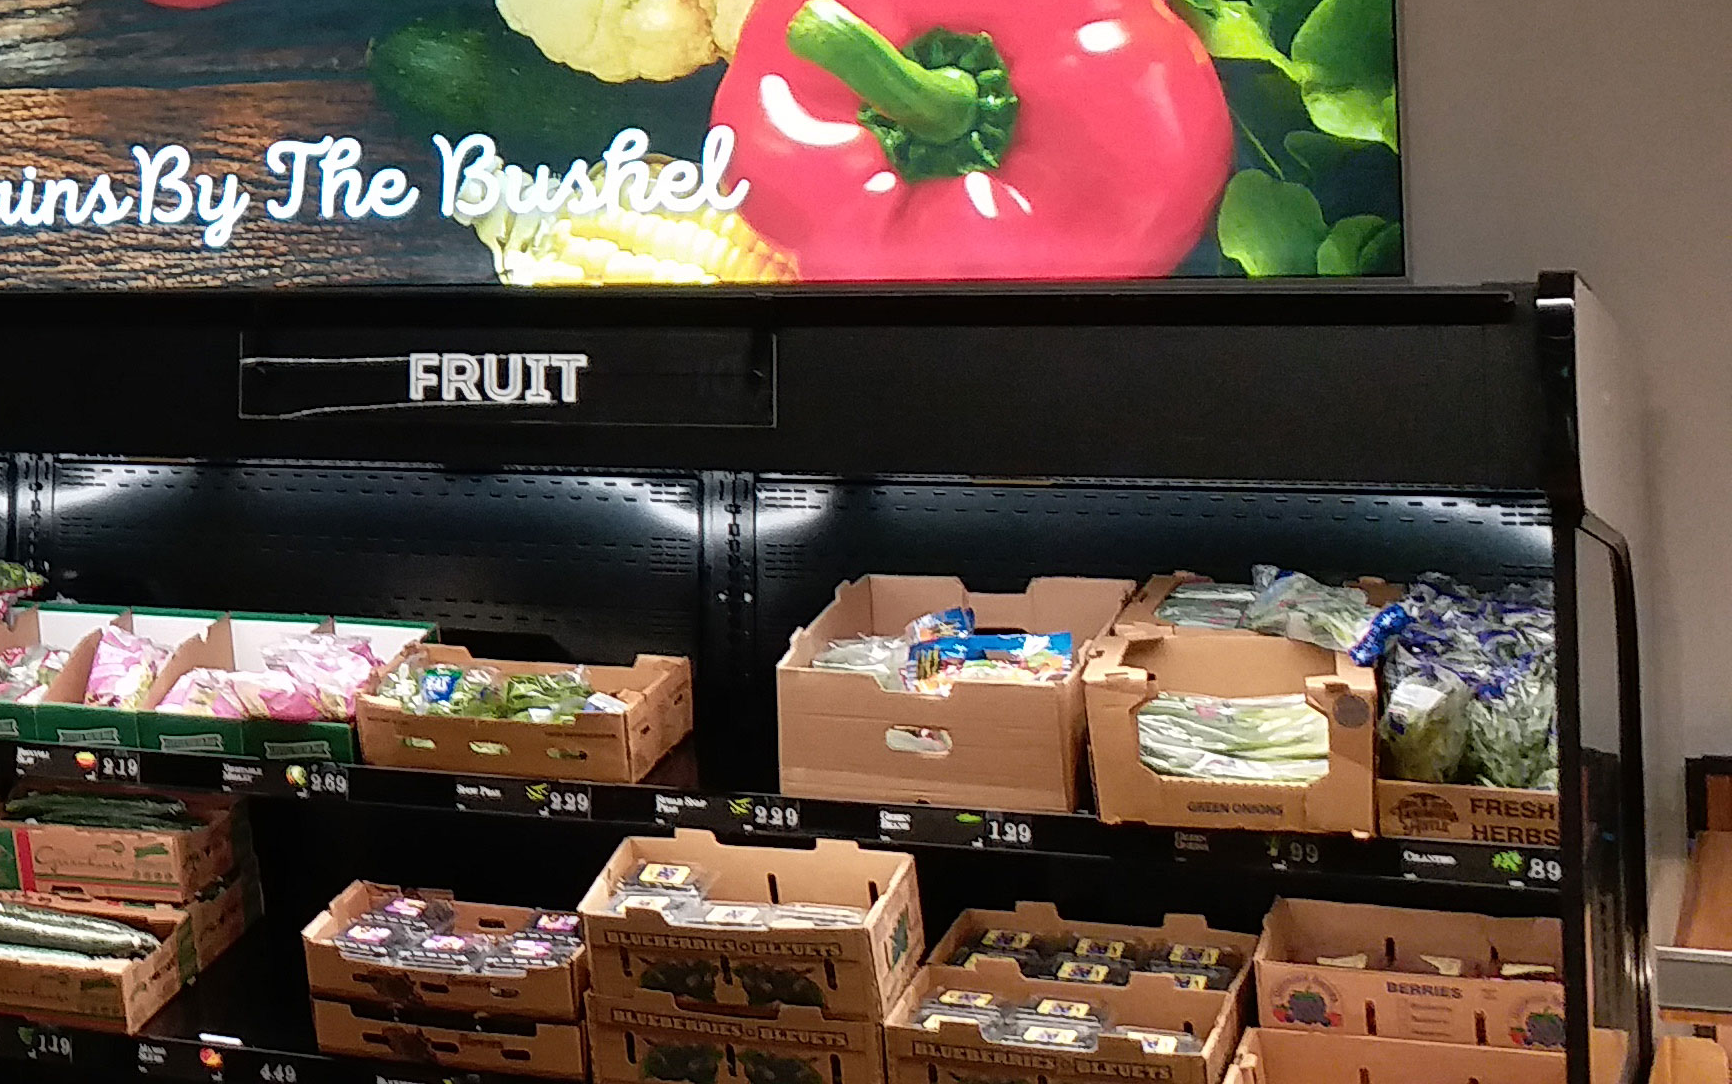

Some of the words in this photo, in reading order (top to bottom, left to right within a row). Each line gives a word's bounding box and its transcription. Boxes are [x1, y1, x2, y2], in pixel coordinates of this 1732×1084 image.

[131, 144, 251, 249] By
[266, 134, 421, 218] The
[431, 123, 752, 218] Bushel
[408, 352, 590, 404] FRUIT
[1186, 801, 1230, 814] GREEN
[1231, 802, 1284, 816] ONIONS
[1469, 796, 1556, 821] FRESH
[1470, 822, 1560, 847] HERBS
[605, 930, 736, 953] BLUEBERRIES
[1385, 980, 1464, 1000] BERRIES
[611, 1007, 743, 1038] BLUEBERRIES
[912, 1040, 1058, 1070] BLUEBERRIES
